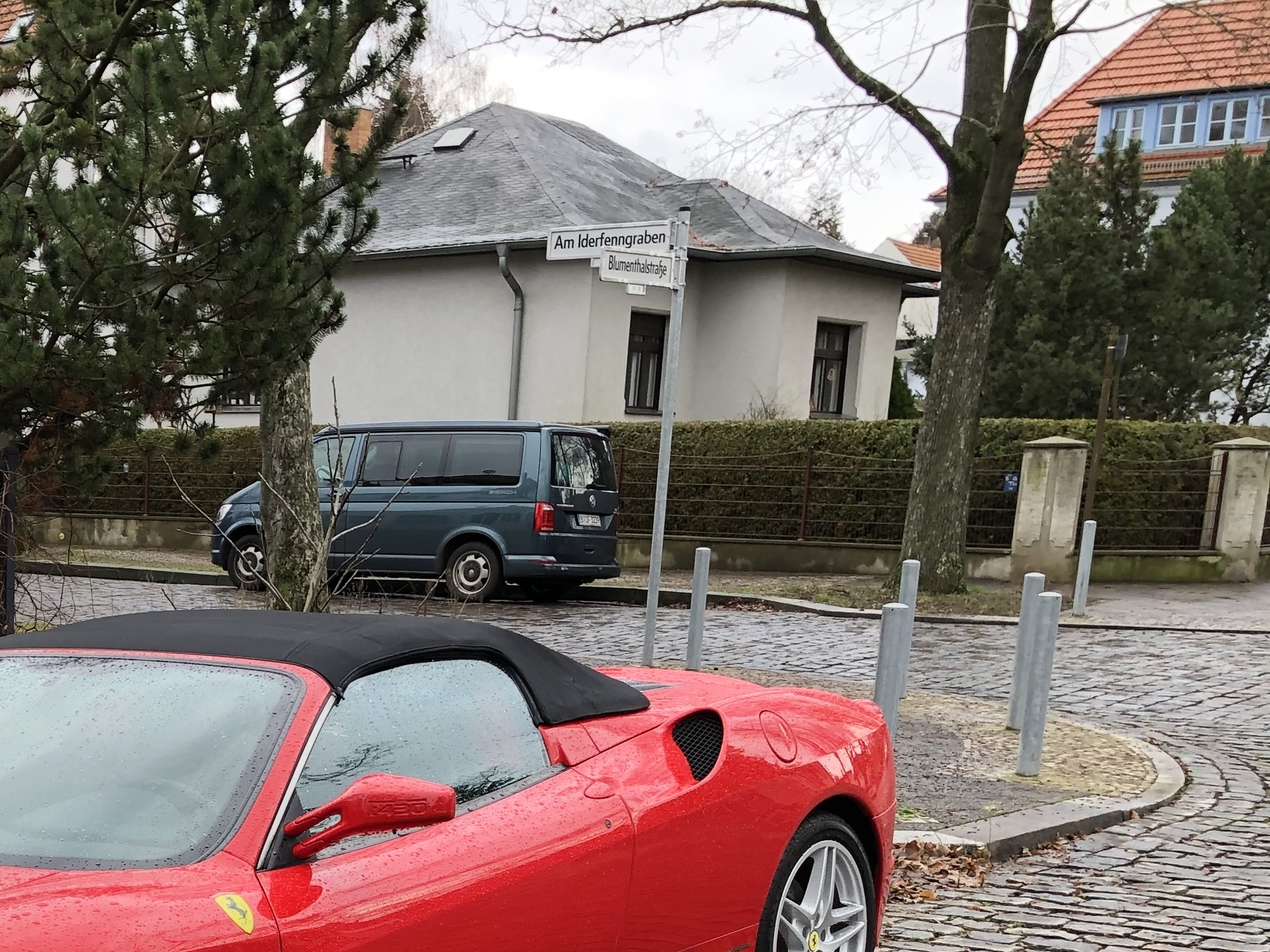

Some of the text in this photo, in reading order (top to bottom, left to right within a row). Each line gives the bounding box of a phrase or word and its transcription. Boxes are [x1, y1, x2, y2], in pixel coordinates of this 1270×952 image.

[554, 230, 666, 250] Am Iderfenngraben
[608, 254, 668, 279] Blumenthalstraße
